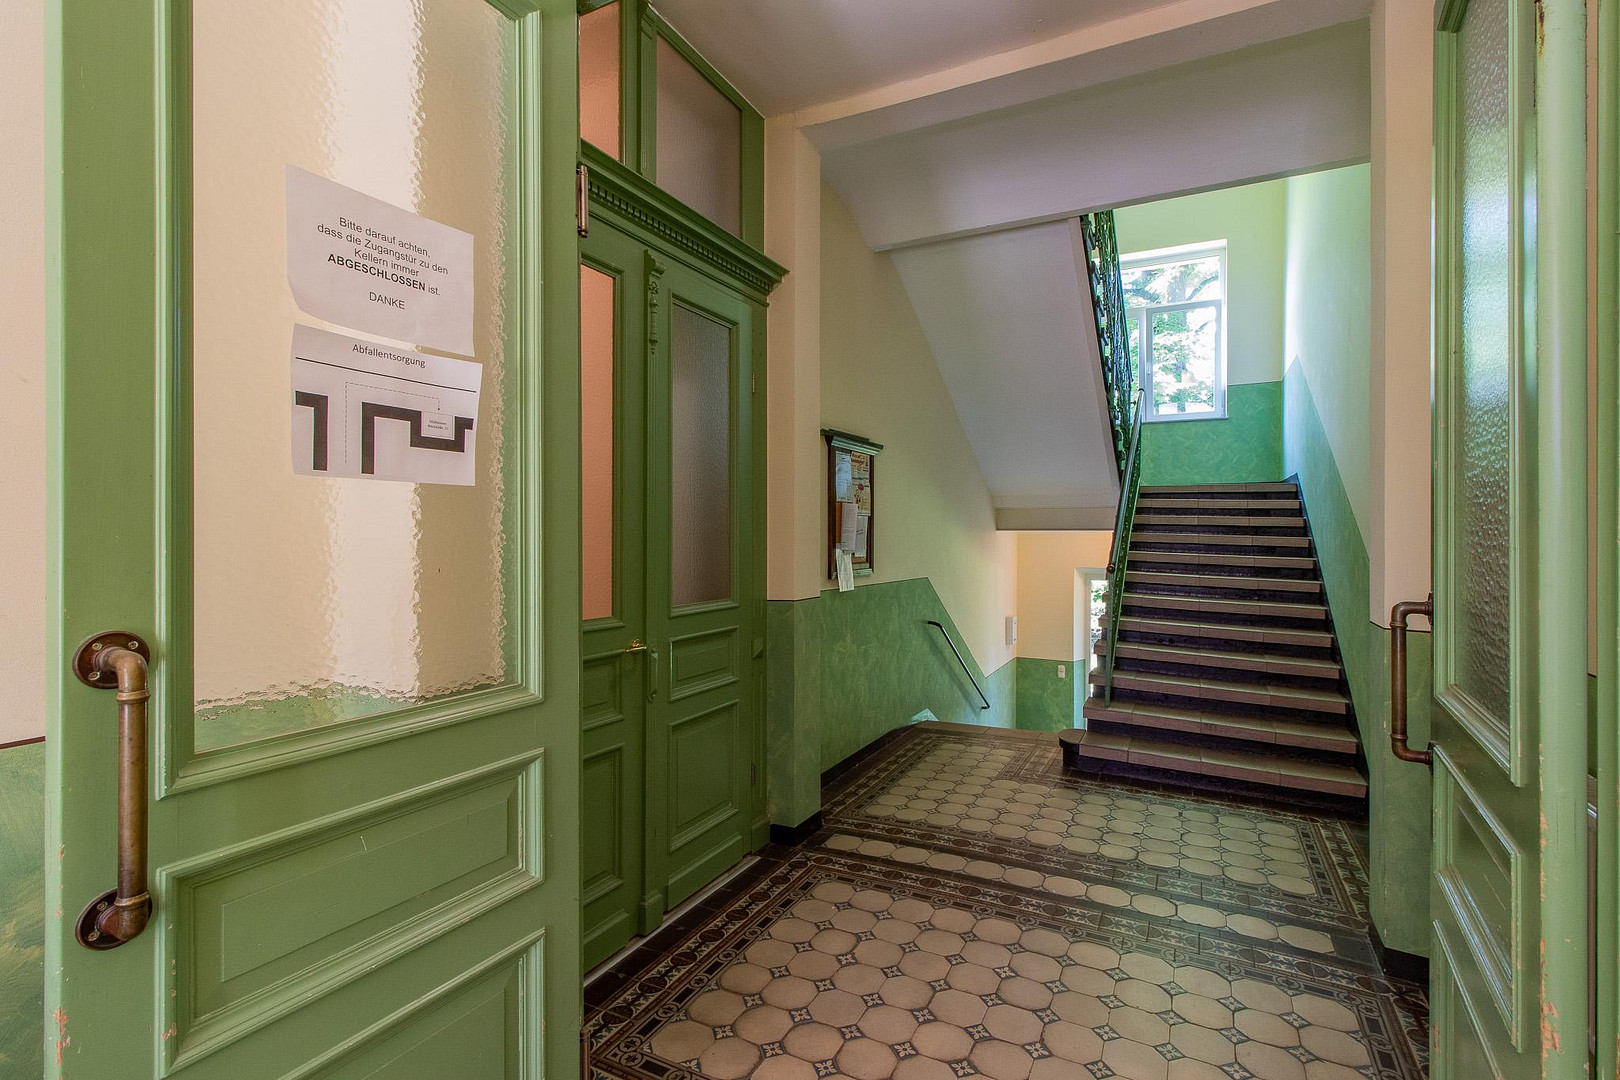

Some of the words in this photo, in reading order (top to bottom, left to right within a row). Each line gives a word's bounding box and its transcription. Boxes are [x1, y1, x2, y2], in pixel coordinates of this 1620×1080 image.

[340, 217, 363, 233] Bitte
[365, 228, 396, 245] darauf
[317, 224, 343, 239] dass
[346, 234, 362, 245] die
[364, 239, 417, 264] Zugangstür
[419, 260, 430, 269] zu
[432, 264, 449, 275] den
[354, 248, 388, 267] Kellern
[391, 261, 419, 277] immer
[328, 254, 426, 291] ABGESCHLOSSEN
[428, 285, 441, 296] ist.
[369, 292, 405, 310] DANKE
[352, 344, 426, 368] Abfallentsorgung
